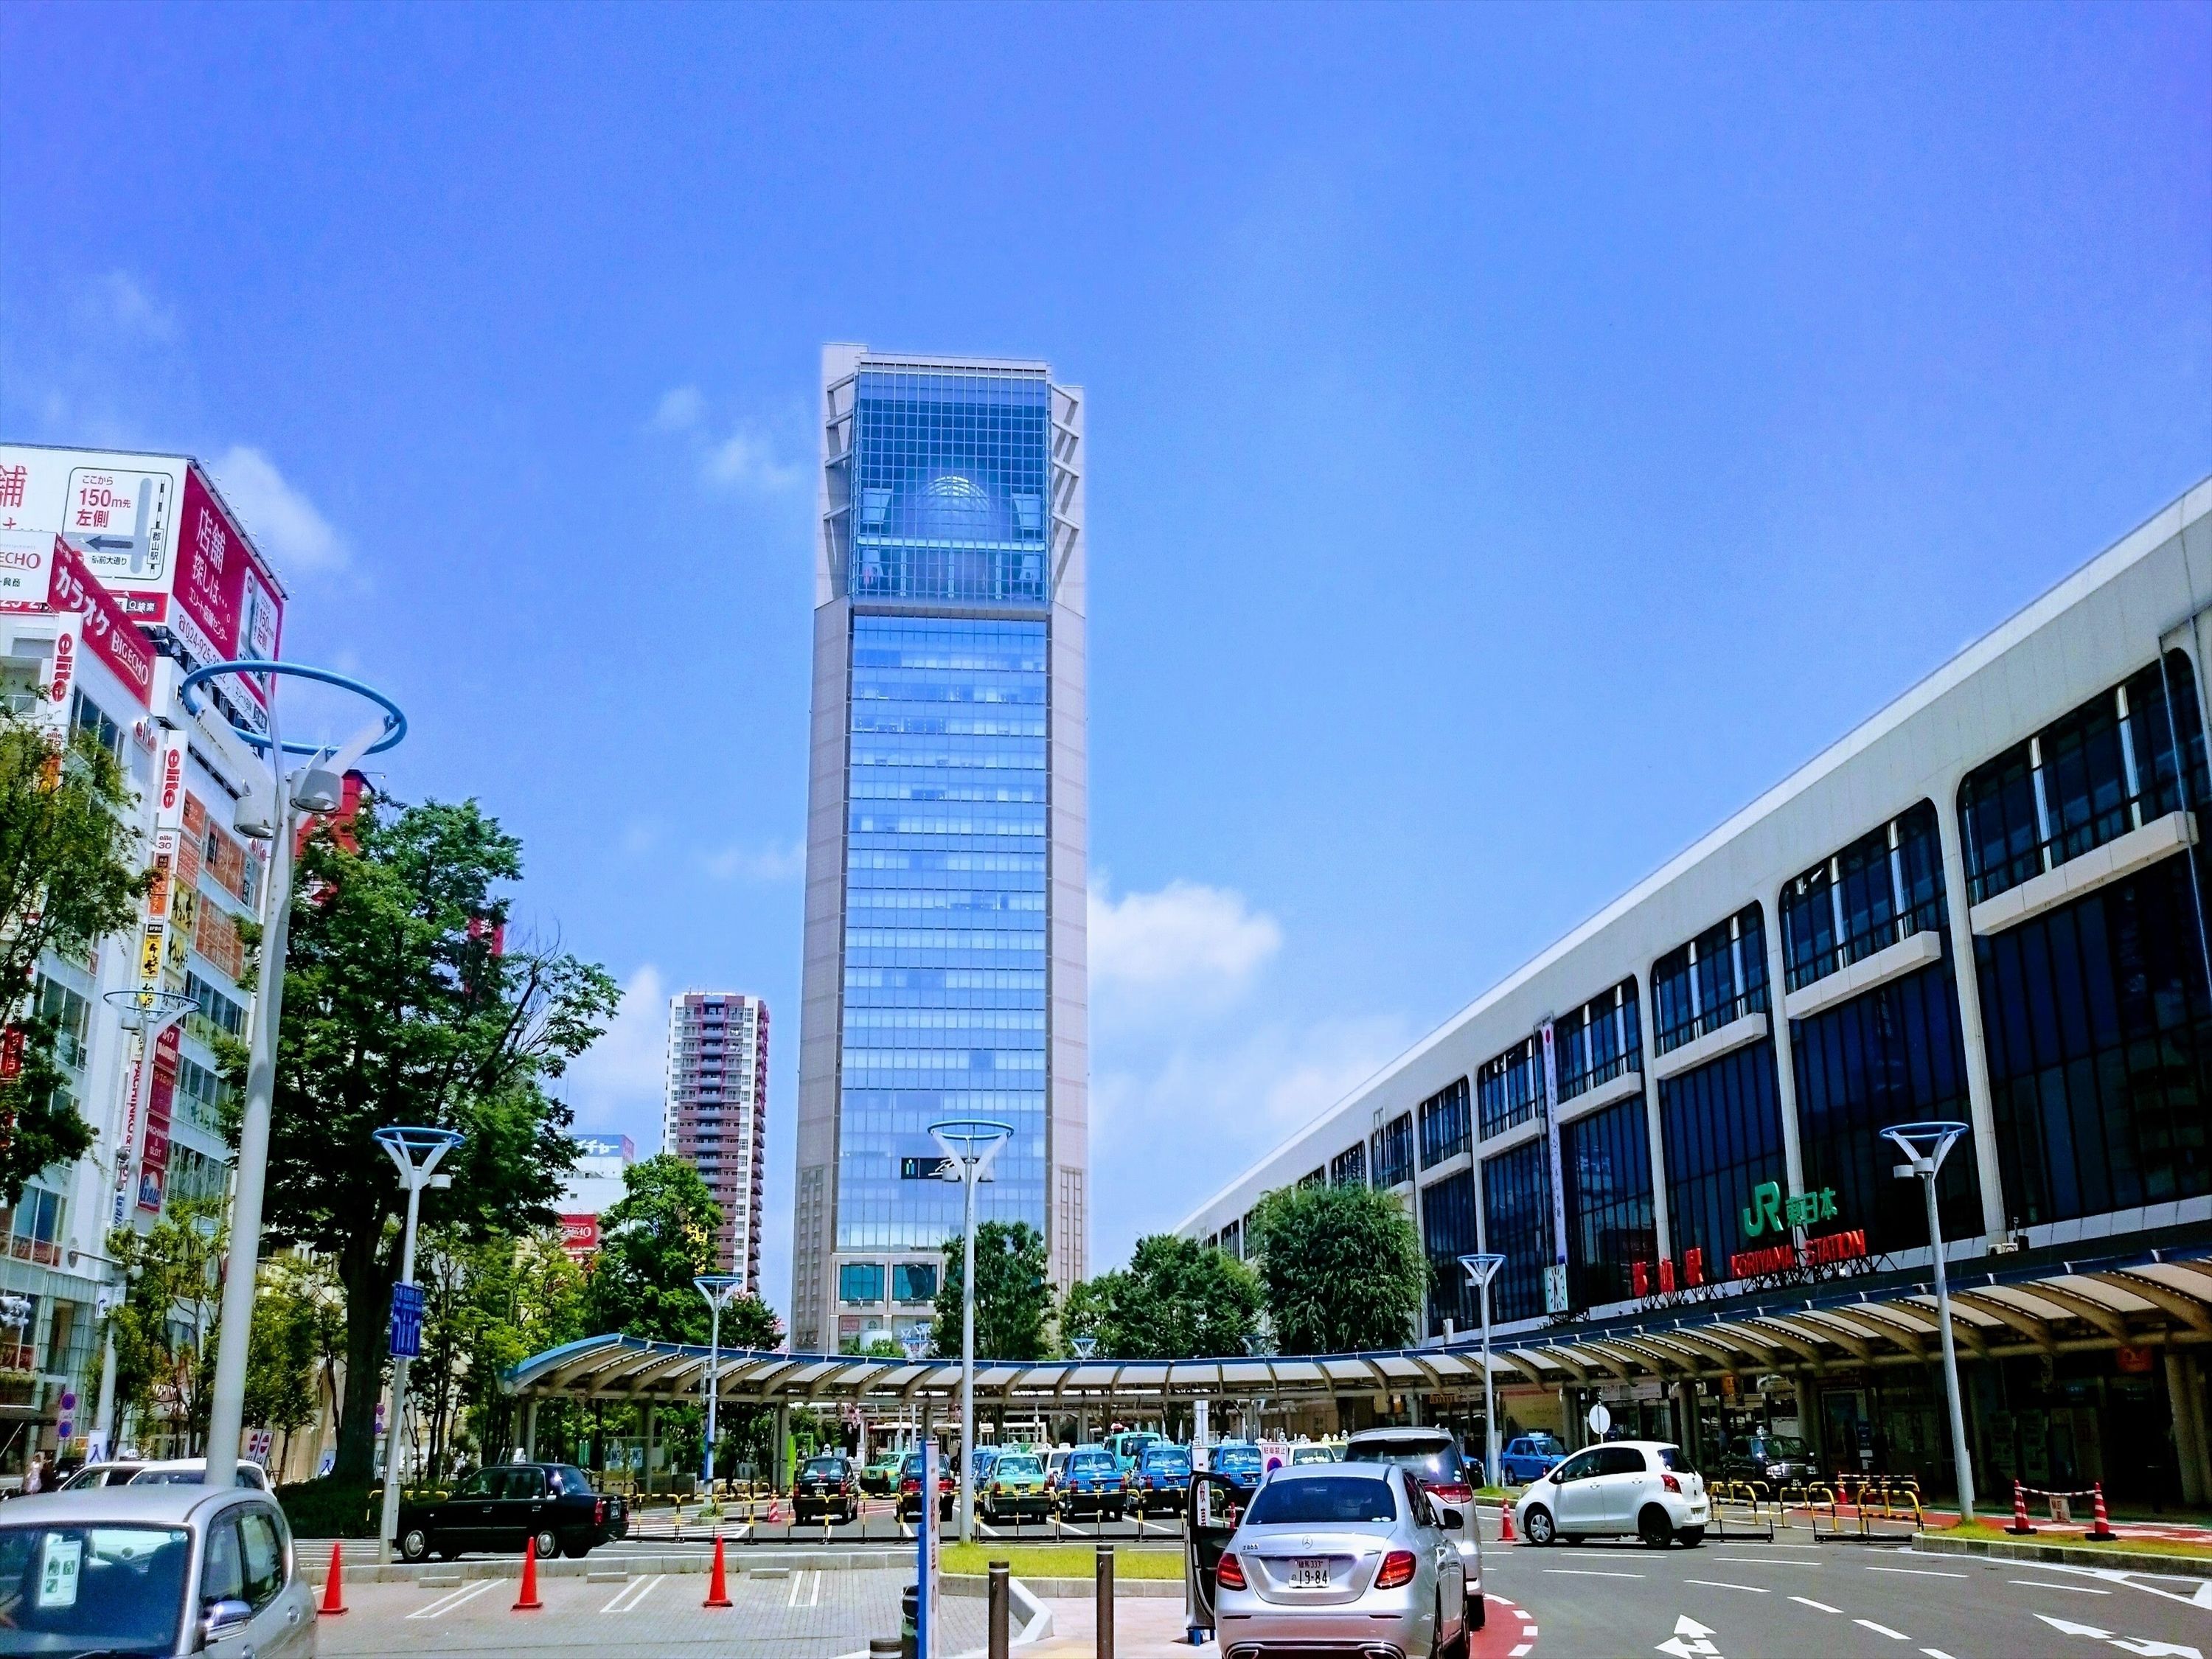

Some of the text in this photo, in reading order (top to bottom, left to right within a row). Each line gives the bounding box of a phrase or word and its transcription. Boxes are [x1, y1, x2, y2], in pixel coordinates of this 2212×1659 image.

[79, 488, 131, 509] 150m先
[82, 476, 114, 486] ここから
[76, 509, 109, 528] 左側
[196, 507, 226, 574] 店舗
[150, 532, 161, 560] 郡山駅
[56, 566, 111, 636] カラオケ
[52, 633, 72, 702] elite
[111, 630, 128, 658] BIG
[128, 650, 148, 685] ECHO
[163, 748, 180, 809] elite
[1743, 1180, 1784, 1237] JR
[1786, 1186, 1838, 1228] 東日本
[1731, 1229, 1867, 1279] KORIYAMA STATION
[1263, 1446, 1286, 1455] 駐車禁止
[1299, 1570, 1327, 1585] 19-84
